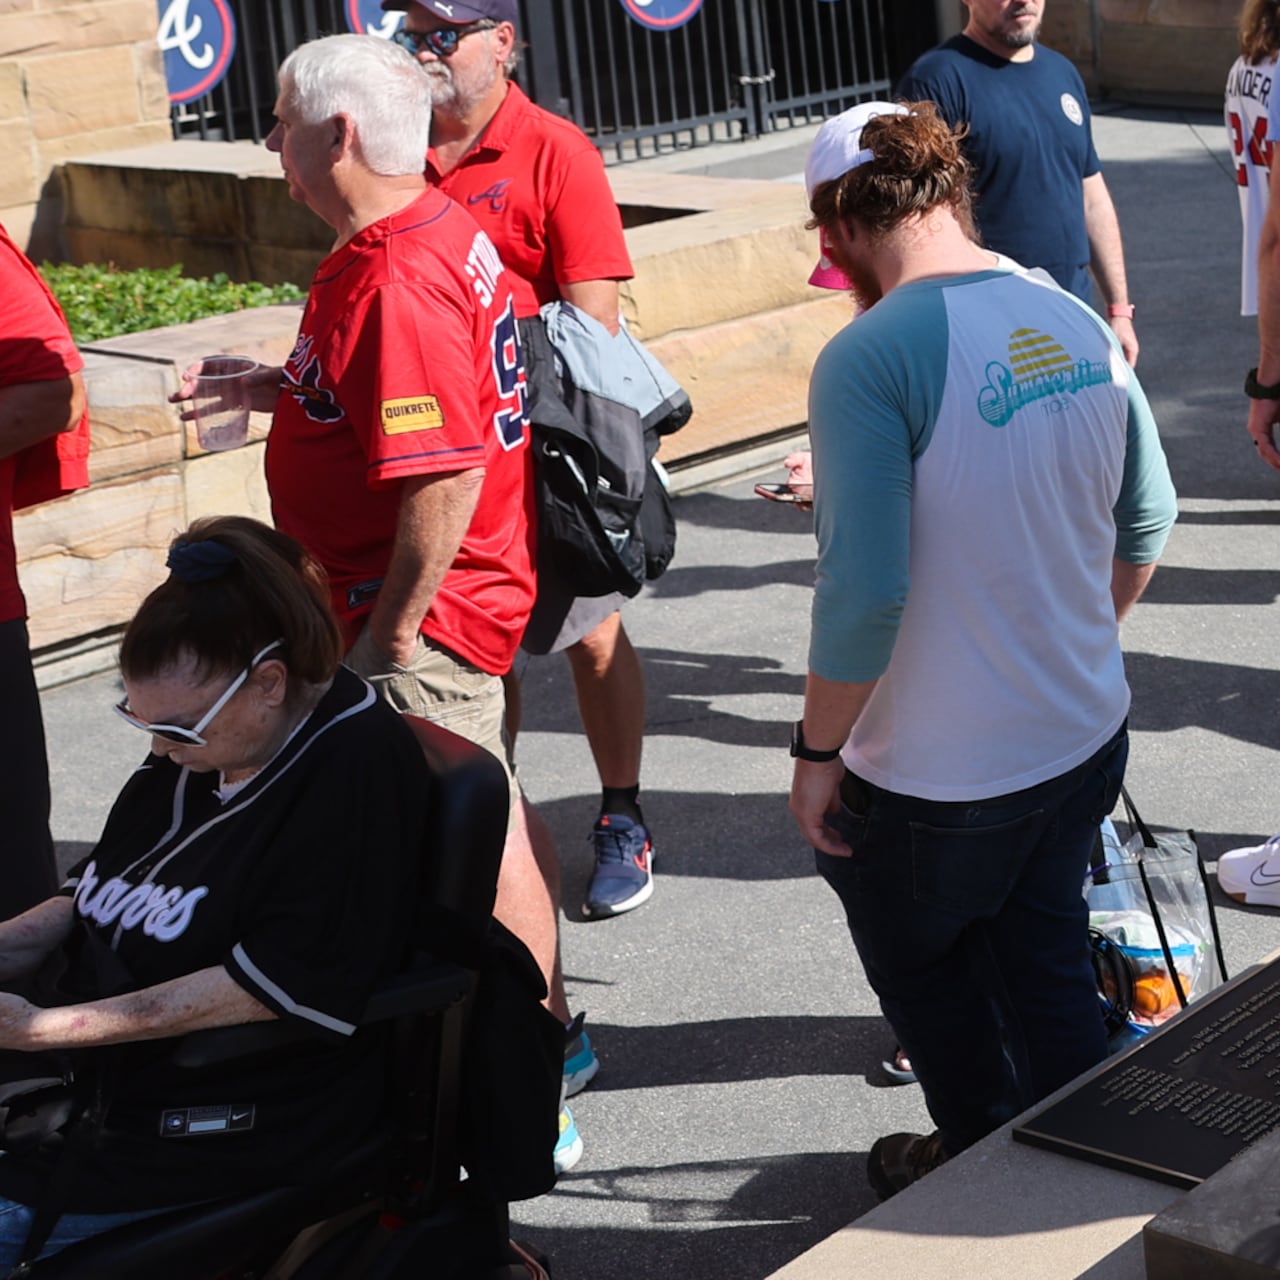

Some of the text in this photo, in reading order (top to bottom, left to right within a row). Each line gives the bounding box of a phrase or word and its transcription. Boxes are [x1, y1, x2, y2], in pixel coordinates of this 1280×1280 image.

[1227, 68, 1271, 108] ANDER
[384, 400, 437, 422] QUIKRETE
[76, 861, 209, 942] raves
